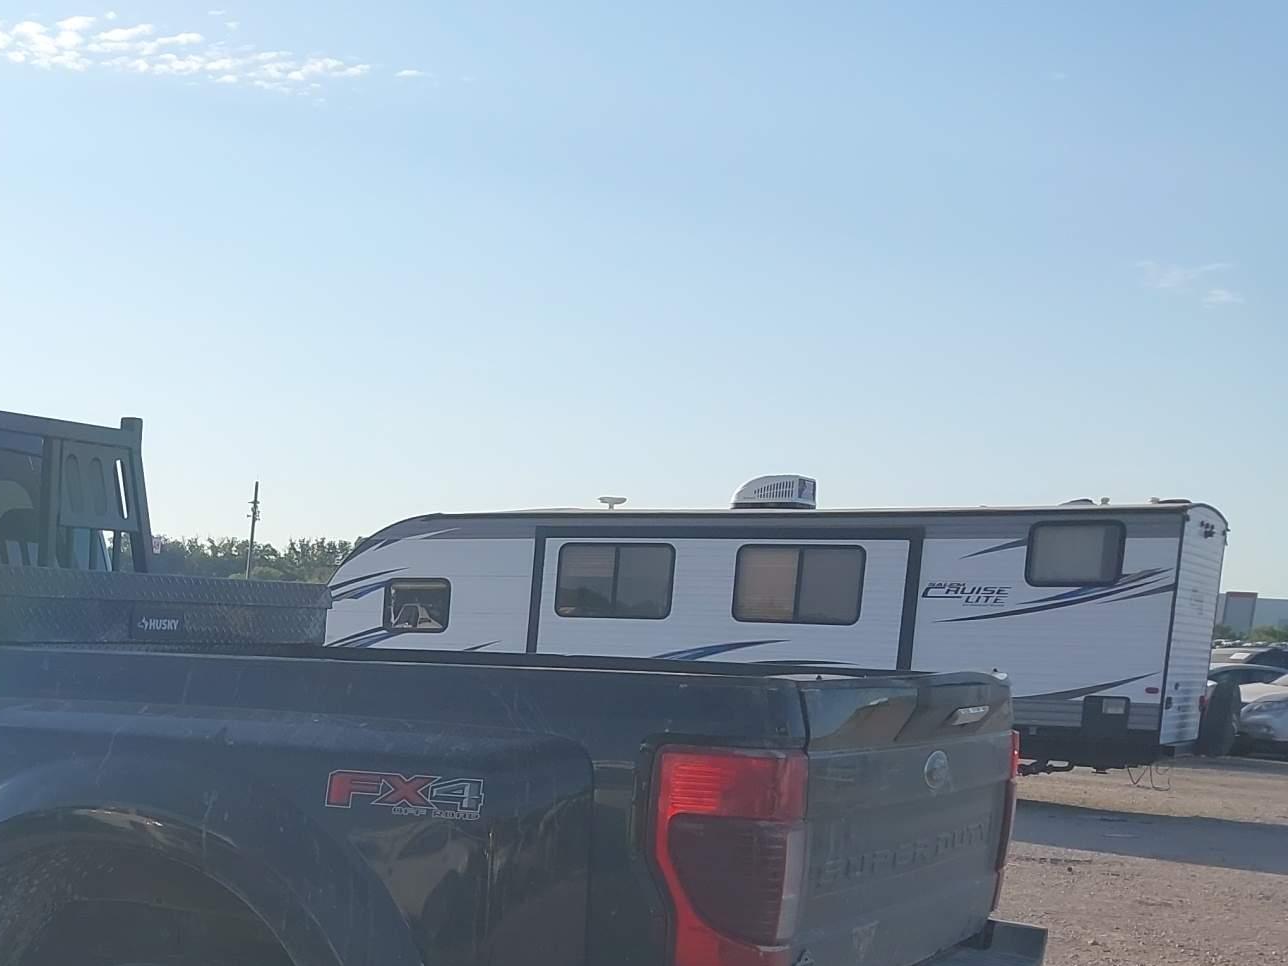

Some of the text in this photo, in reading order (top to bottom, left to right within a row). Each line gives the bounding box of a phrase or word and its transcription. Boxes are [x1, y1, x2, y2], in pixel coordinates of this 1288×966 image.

[921, 586, 1014, 599] CRUISE
[964, 596, 1009, 604] LITE
[149, 619, 179, 631] HUSKY
[324, 769, 485, 813] FX4
